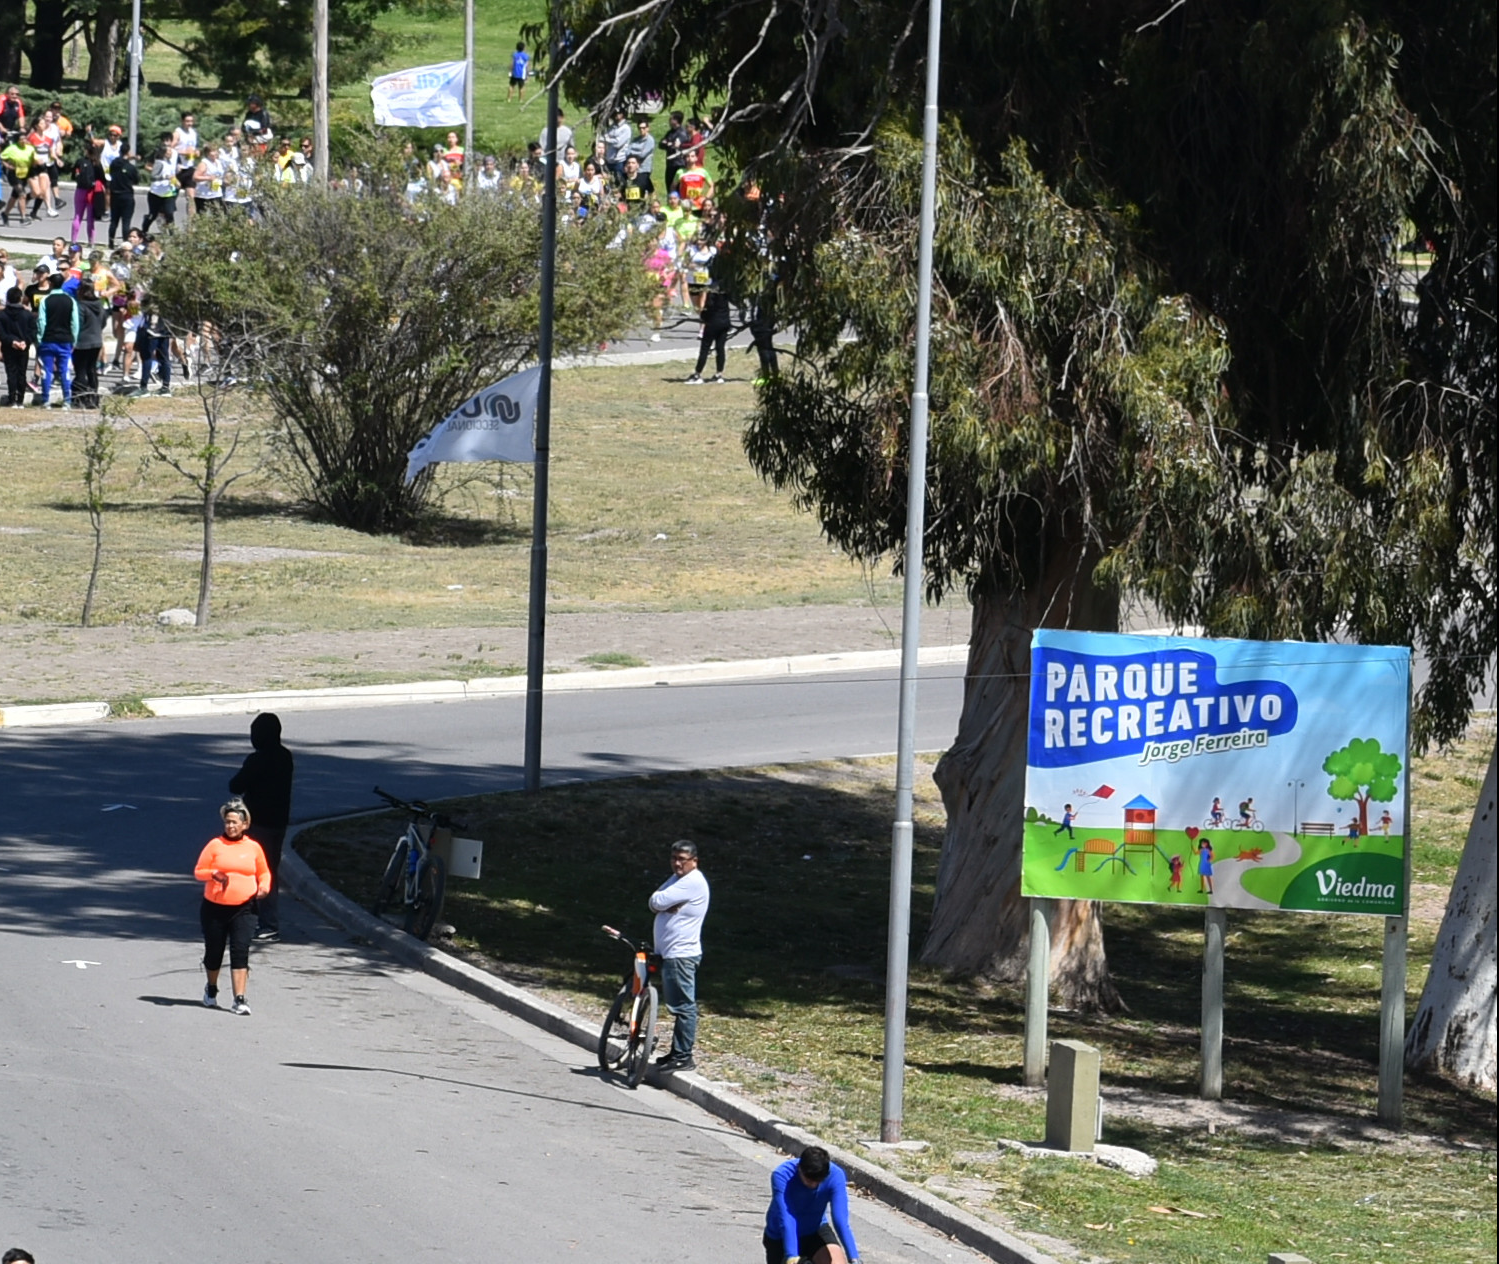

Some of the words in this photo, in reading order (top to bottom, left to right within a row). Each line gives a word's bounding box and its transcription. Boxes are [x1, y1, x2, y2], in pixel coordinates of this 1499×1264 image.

[1046, 662, 1199, 703] PARQUE
[1044, 694, 1282, 748] RECREATIVO
[1142, 740, 1191, 763] Jorge
[1195, 730, 1266, 753] Ferreira
[1315, 869, 1395, 898] Viedma
